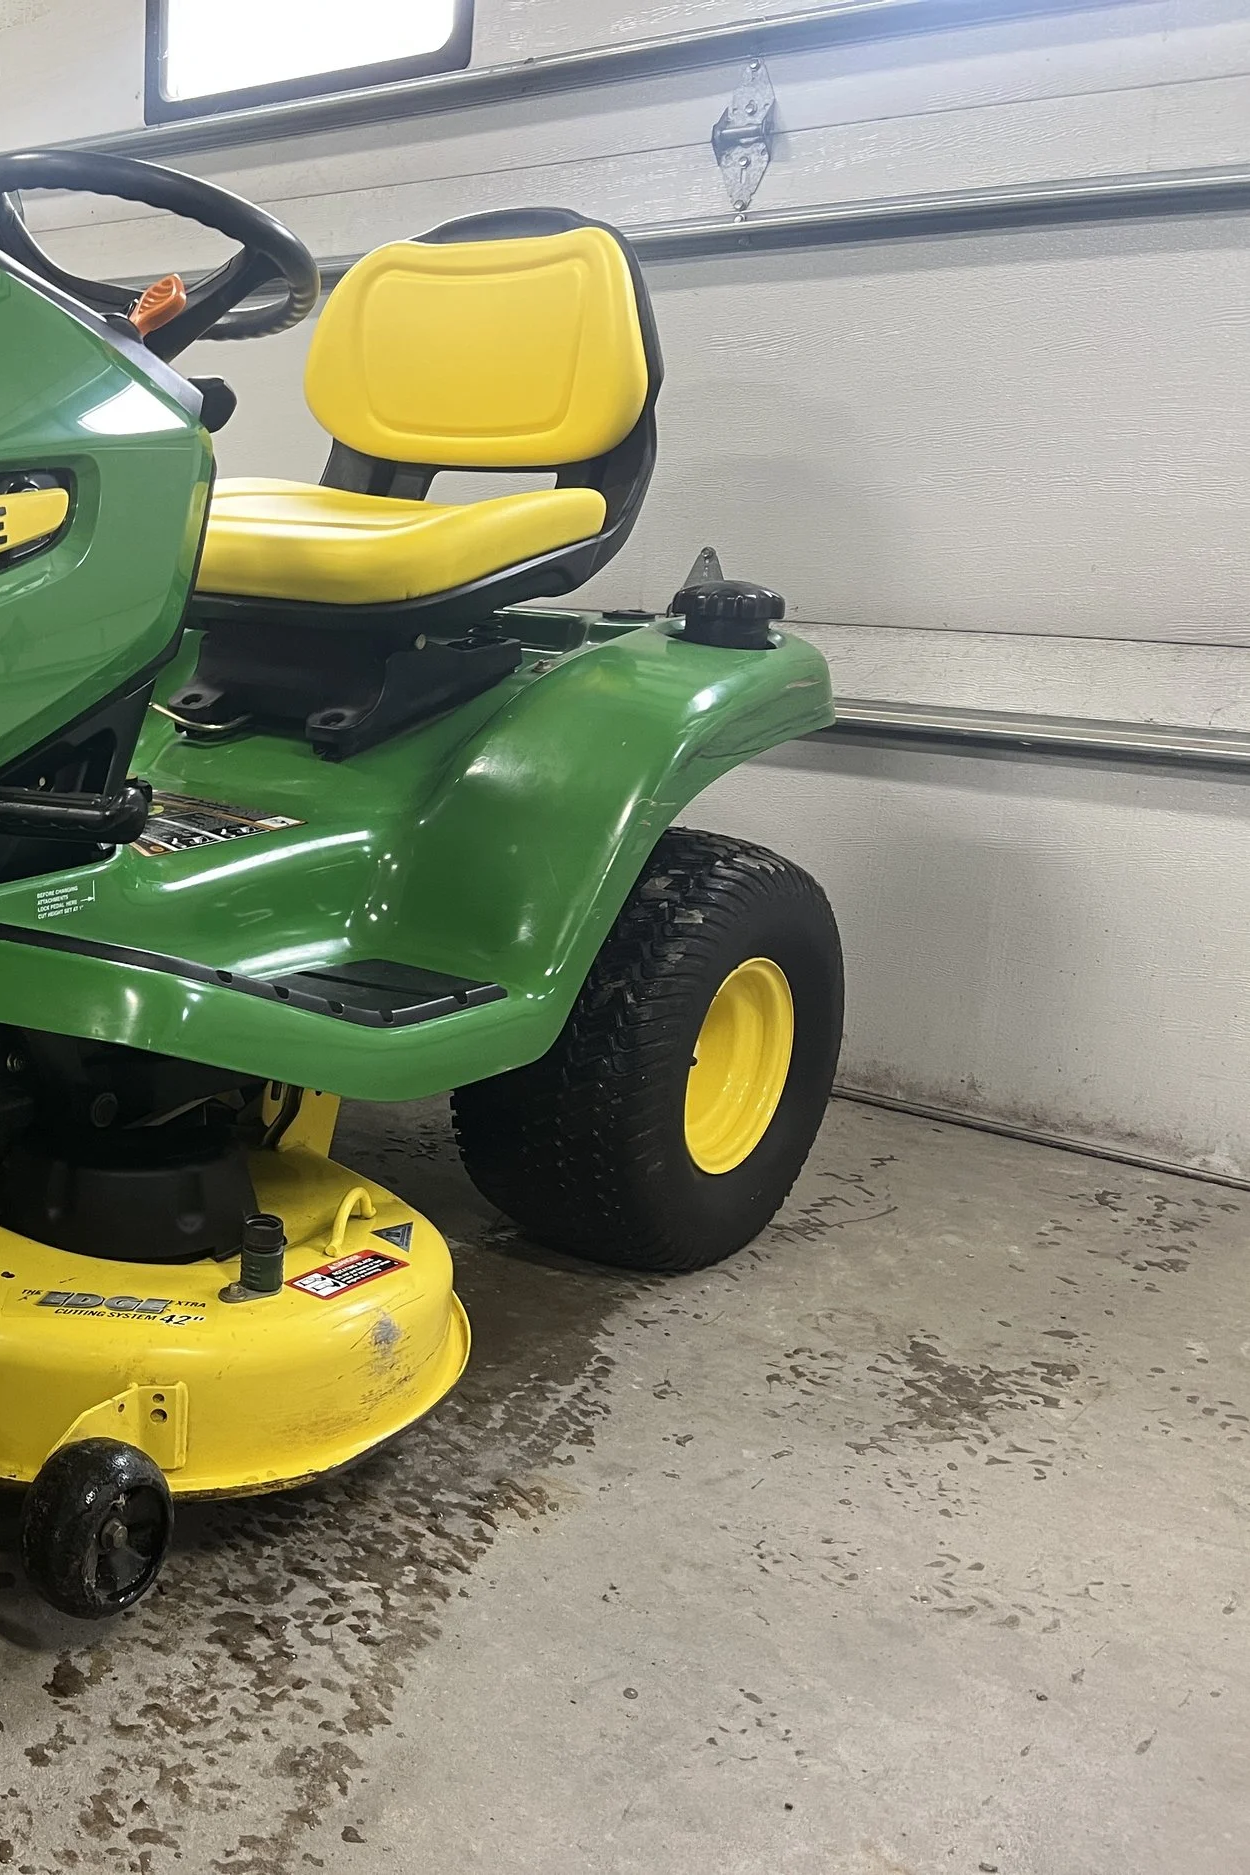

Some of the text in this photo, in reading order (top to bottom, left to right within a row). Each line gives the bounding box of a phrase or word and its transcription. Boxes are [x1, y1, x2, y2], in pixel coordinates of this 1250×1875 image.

[37, 885, 78, 899] BEFORE CHANGING
[37, 894, 68, 905] ATTACHMENTS
[37, 904, 50, 913] LOCK
[50, 902, 65, 910] PEDAL
[35, 1290, 172, 1314] EDGE
[175, 1300, 206, 1308] XTRA
[54, 1308, 205, 1326] CUTTING SYSTEM 42"
